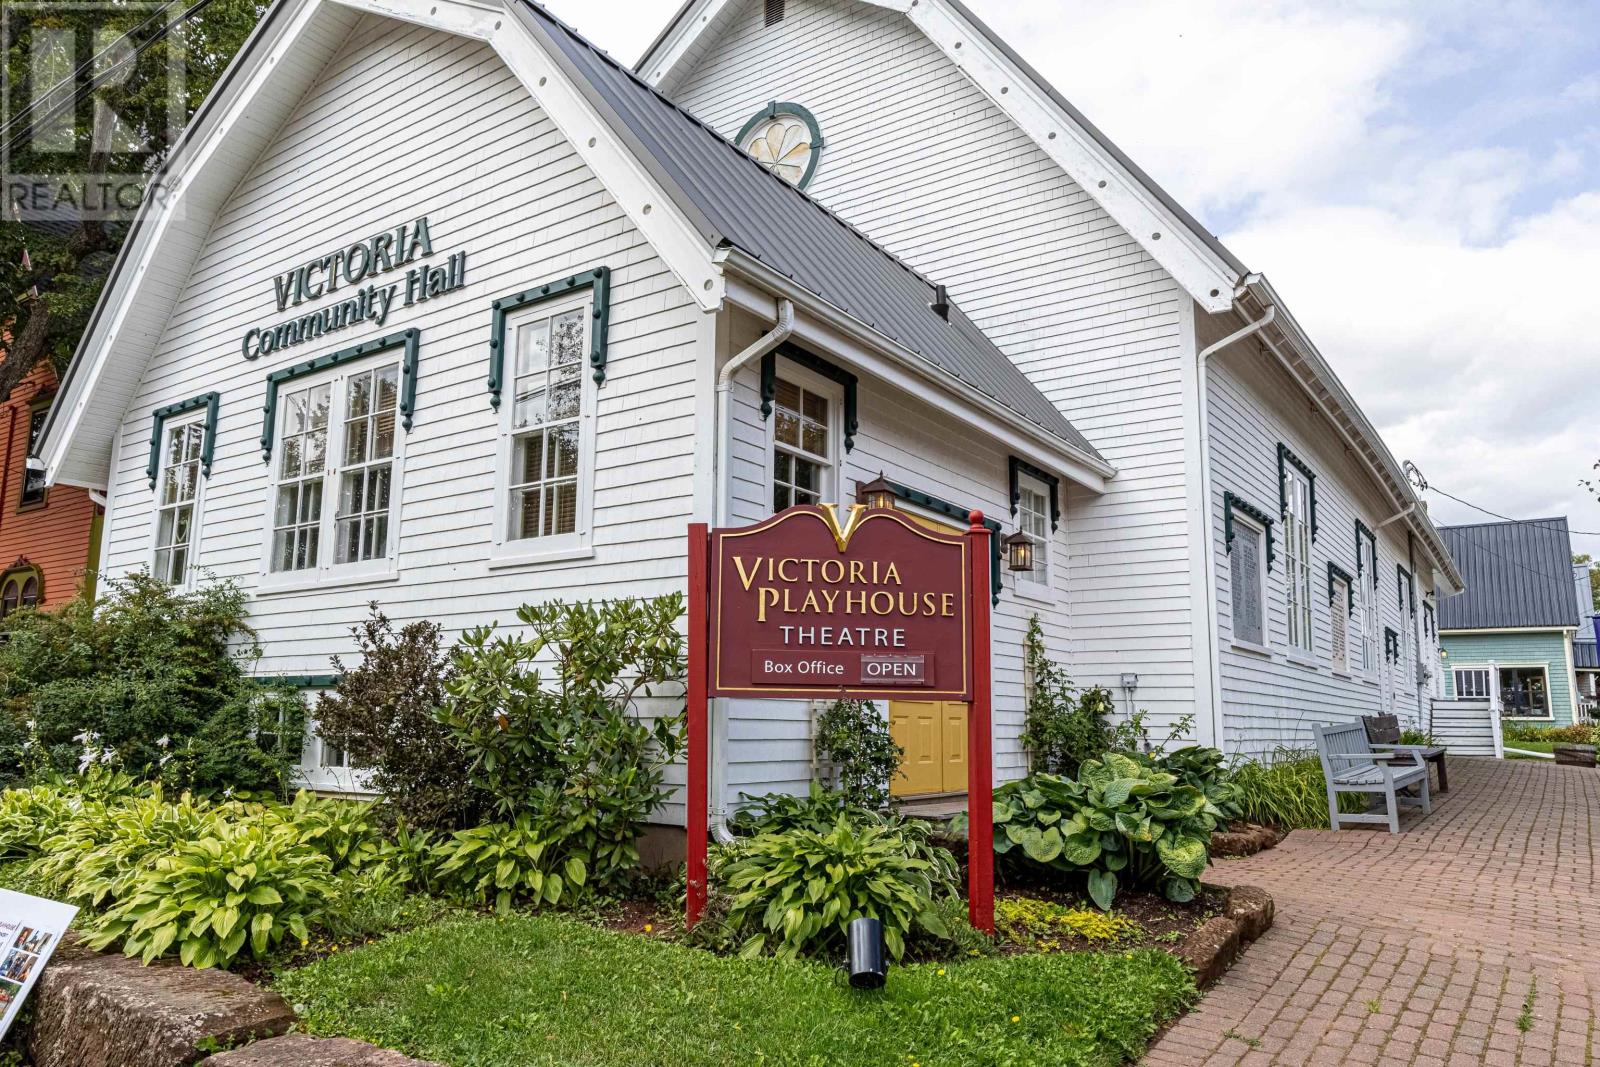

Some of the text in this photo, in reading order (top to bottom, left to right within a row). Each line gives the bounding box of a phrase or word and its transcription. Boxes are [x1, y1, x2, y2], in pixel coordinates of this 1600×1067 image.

[273, 216, 434, 312] VICTORIA
[241, 250, 466, 361] Community Hall
[815, 503, 869, 553] V
[732, 556, 902, 591] VICTORIA
[756, 587, 955, 622] PLAYHOUSE
[779, 625, 906, 648] THEATRE
[764, 660, 917, 676] Box Office OPEN
